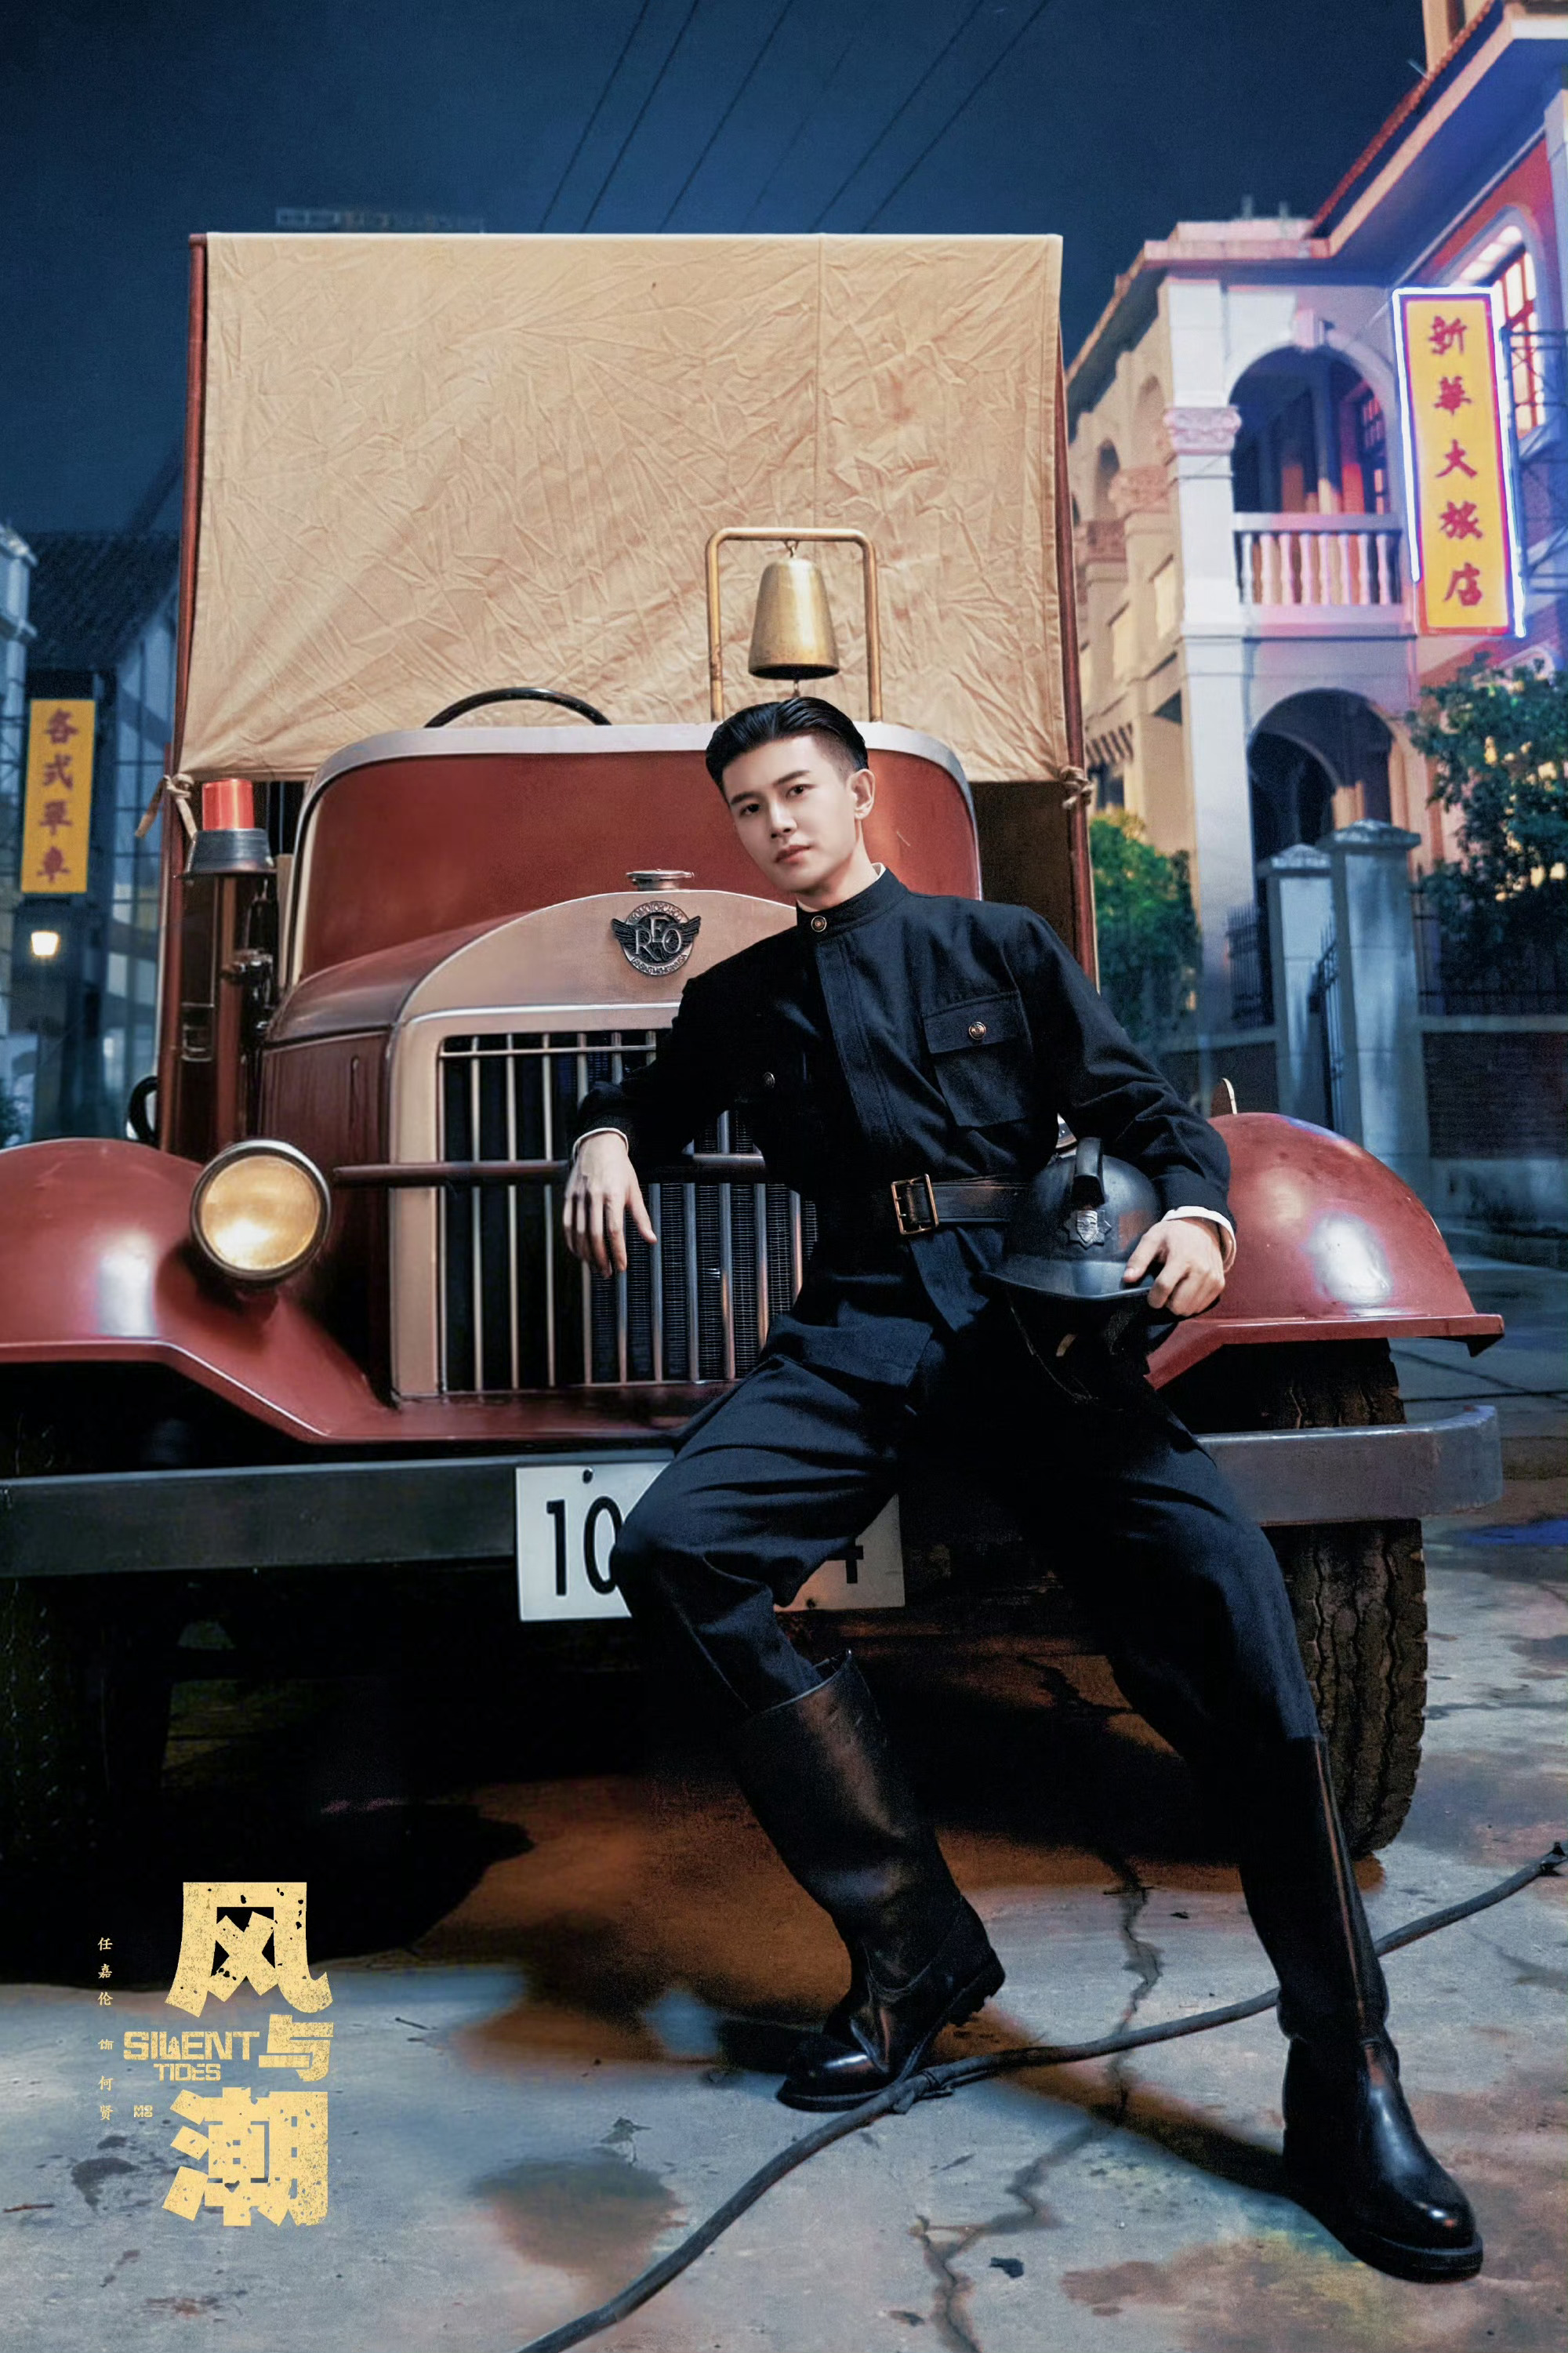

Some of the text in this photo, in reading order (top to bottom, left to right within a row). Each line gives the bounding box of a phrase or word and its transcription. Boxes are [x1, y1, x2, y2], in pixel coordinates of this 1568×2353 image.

[1428, 315, 1484, 607] 新華大旅店
[37, 707, 79, 884] 各式單車
[635, 916, 682, 961] REO
